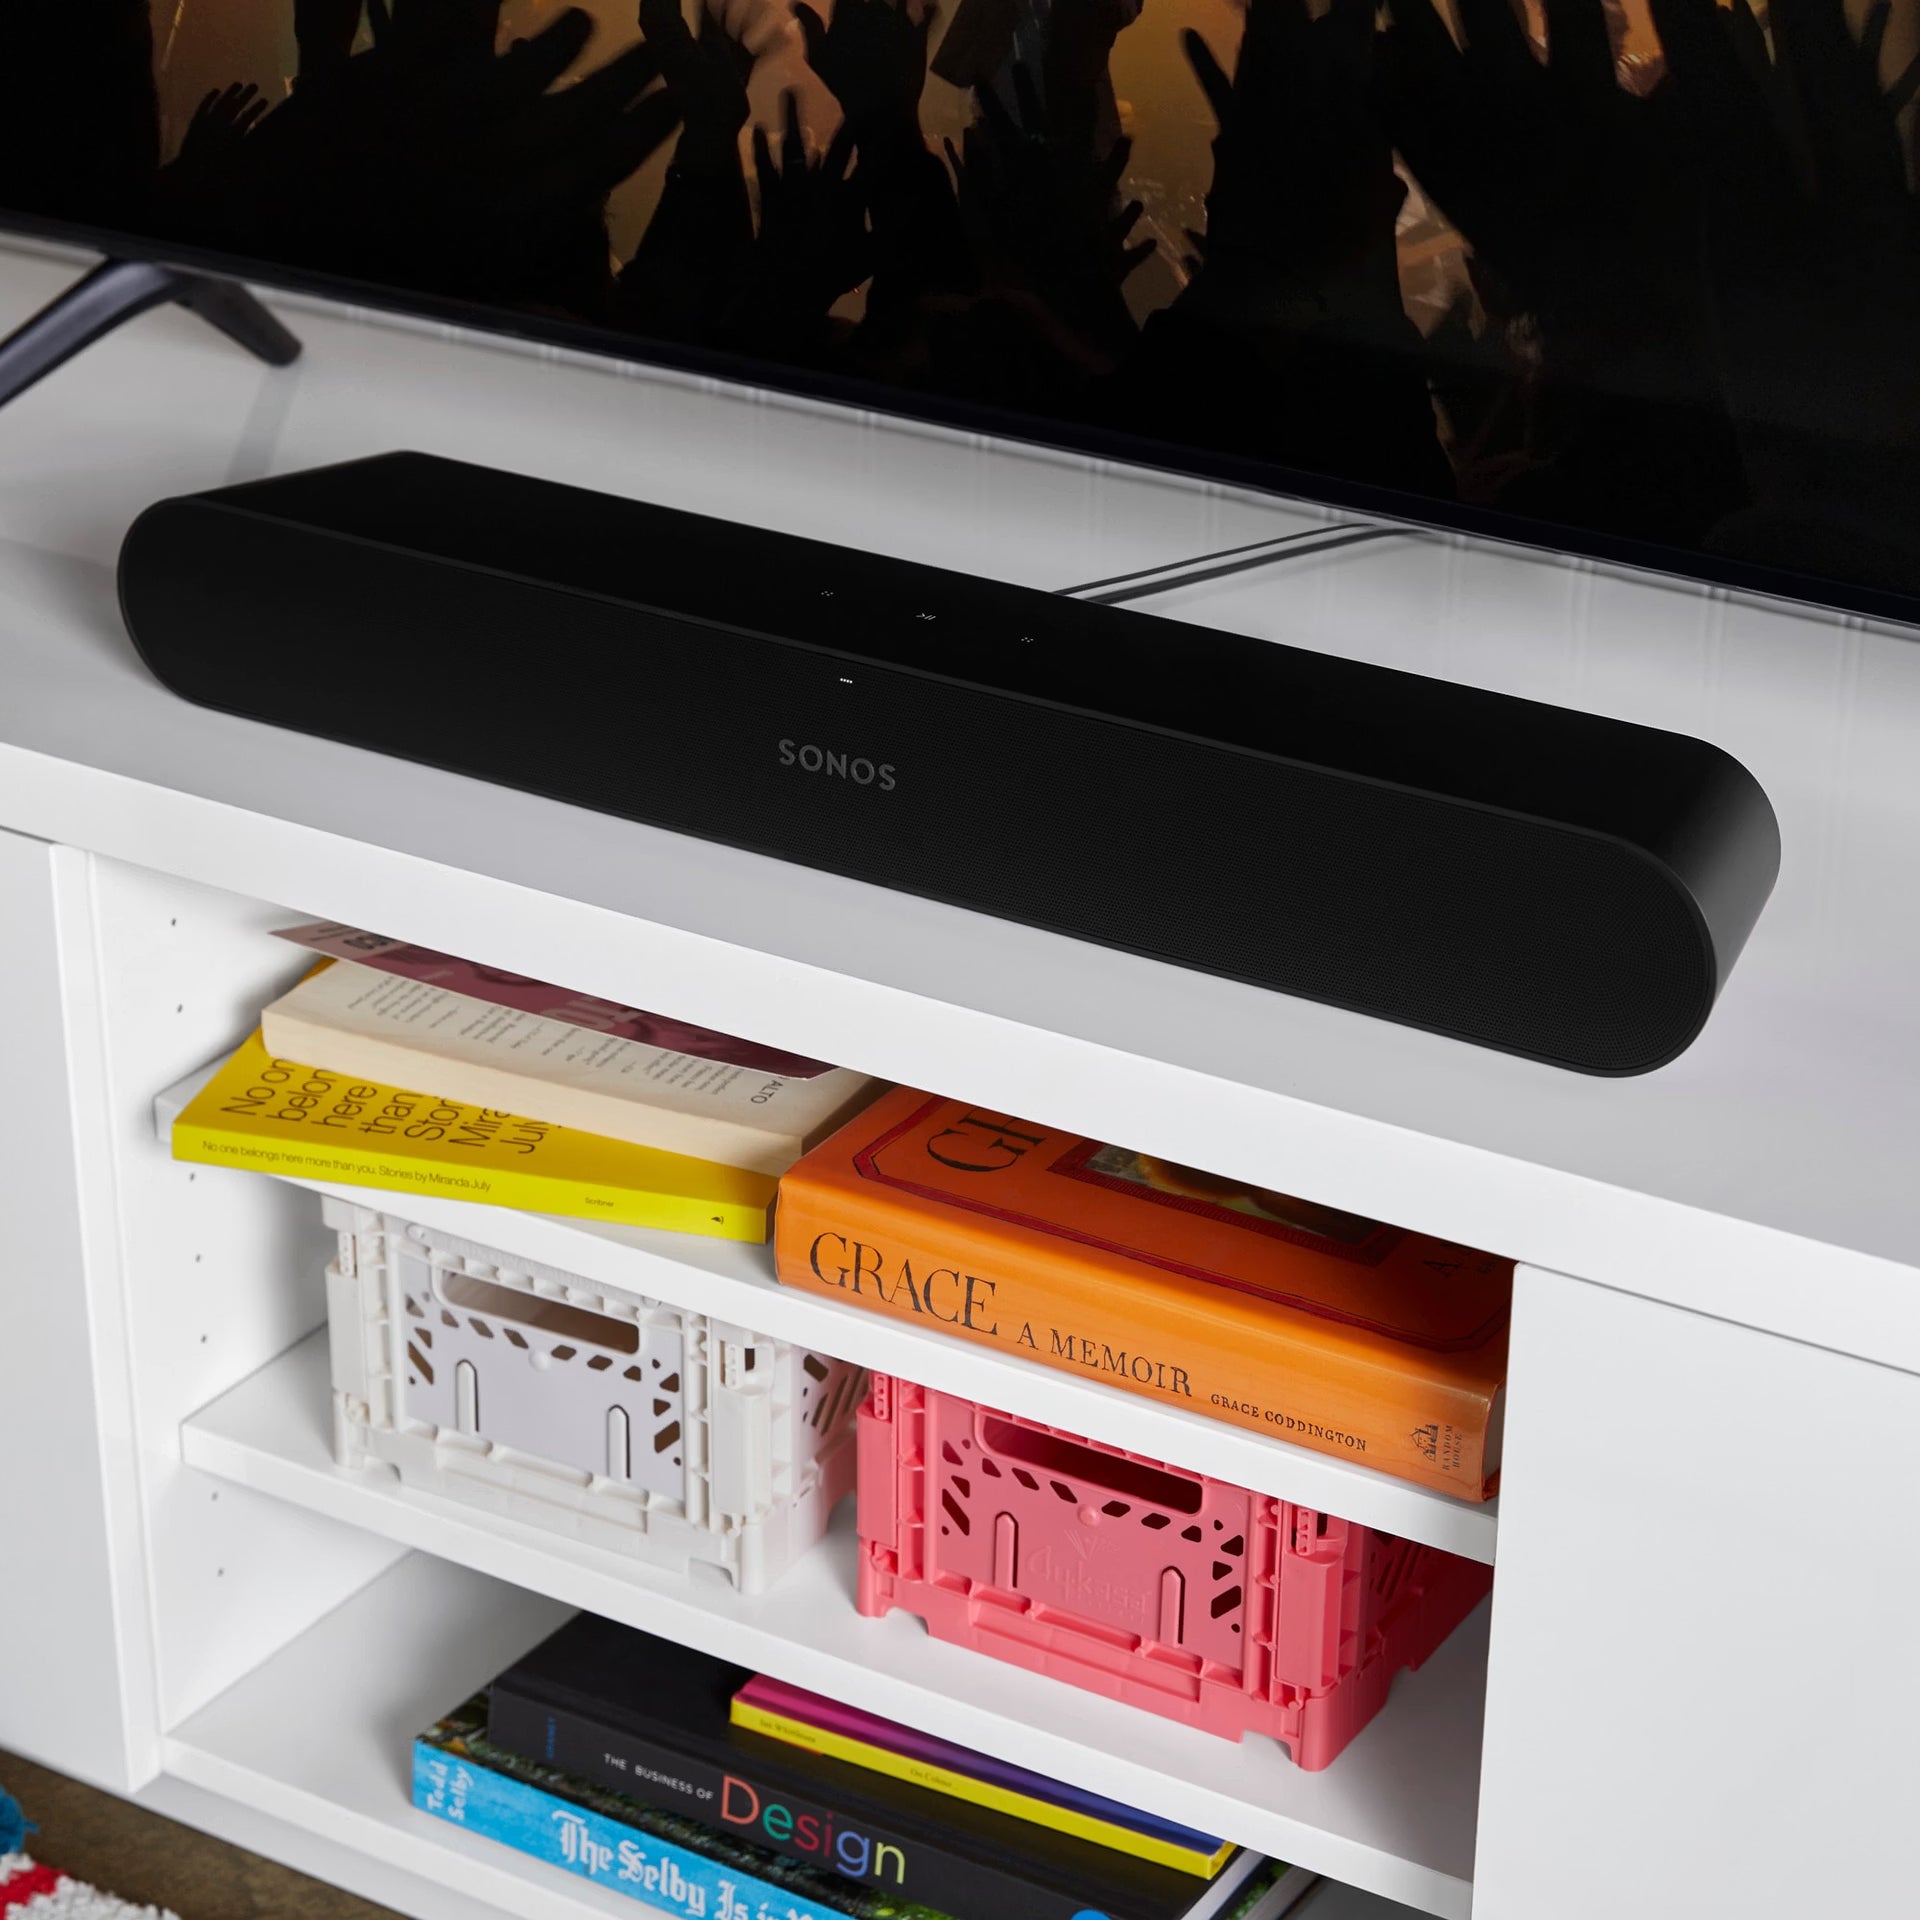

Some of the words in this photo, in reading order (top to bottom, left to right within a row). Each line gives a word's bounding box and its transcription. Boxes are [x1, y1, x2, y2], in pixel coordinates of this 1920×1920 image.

[778, 738, 896, 791] SONOS
[220, 1086, 276, 1116] No
[261, 1058, 296, 1084] on
[265, 1069, 337, 1122] belon
[310, 1085, 378, 1128] here
[358, 1092, 424, 1135] than
[750, 1080, 784, 1104] ALTO
[404, 1096, 465, 1142] Stor
[202, 1140, 218, 1153] No
[218, 1144, 239, 1155] one
[240, 1145, 279, 1162] belongs
[281, 1151, 304, 1164] here
[305, 1156, 332, 1169] more
[332, 1159, 355, 1171] than
[378, 1165, 413, 1181] Stories
[414, 1170, 428, 1184] by
[428, 1173, 470, 1189] Miranda
[470, 1178, 492, 1192] July
[809, 1231, 998, 1336] GRACE
[1016, 1321, 1039, 1351] A
[1050, 1327, 1192, 1398] MEMOIR
[1210, 1393, 1260, 1419] GRACE
[1264, 1410, 1367, 1452] CODDINGTON
[427, 1759, 448, 1810] Todd
[448, 1766, 475, 1821] Selby
[604, 1753, 627, 1771] THE
[634, 1764, 694, 1795] BUSINESS
[696, 1787, 714, 1800] OF
[721, 1773, 906, 1885] Design
[551, 1809, 614, 1876] The
[618, 1839, 706, 1918] Selby
